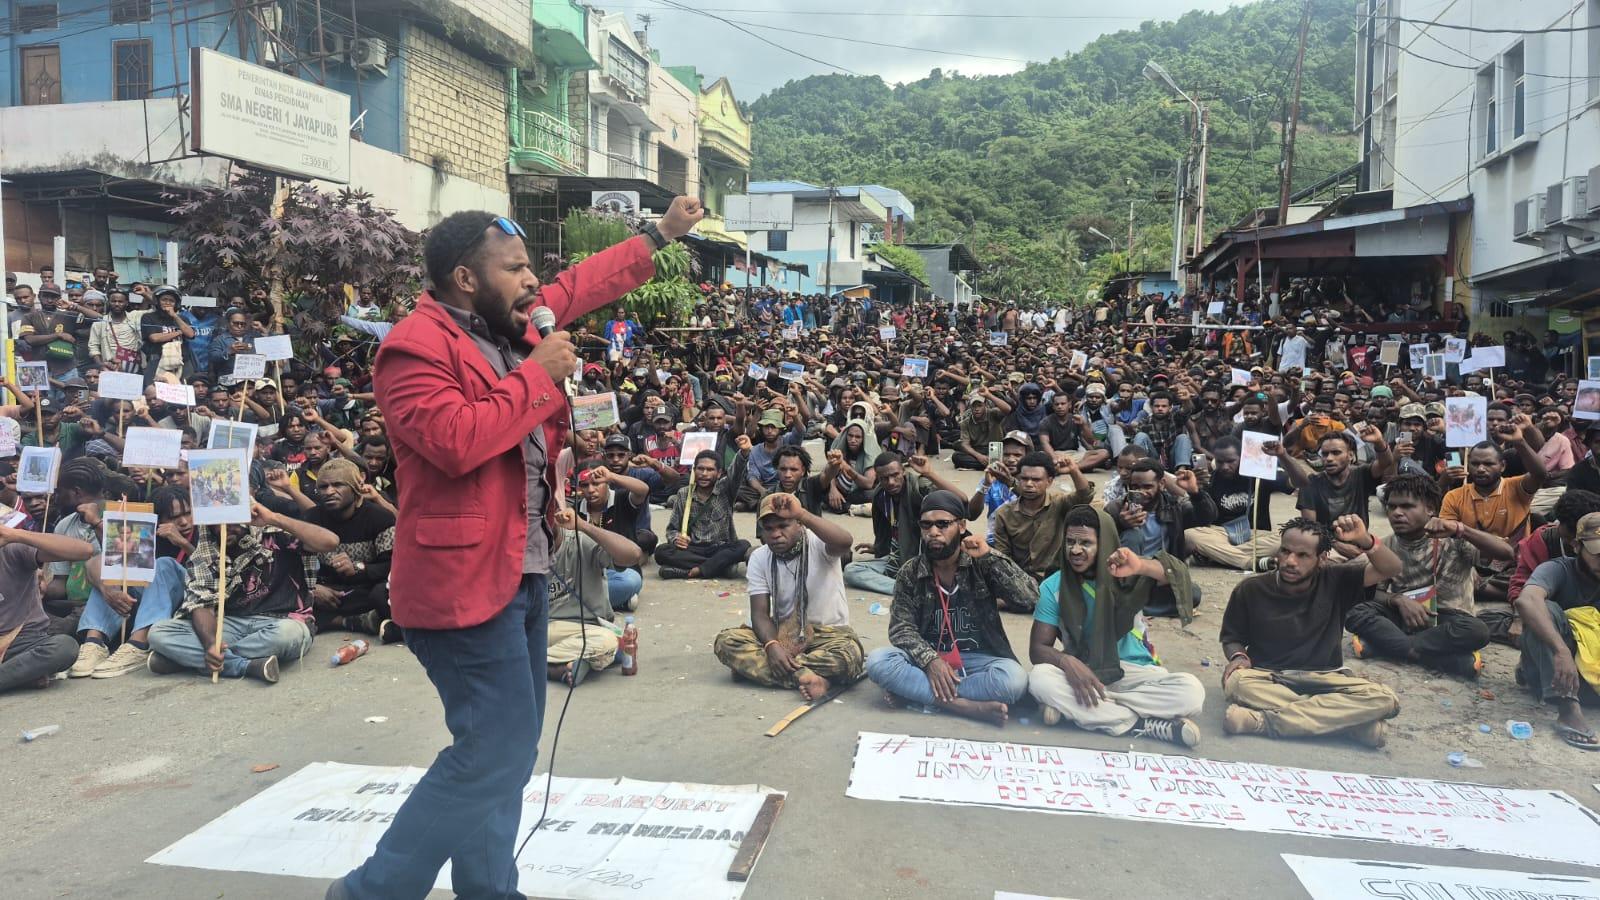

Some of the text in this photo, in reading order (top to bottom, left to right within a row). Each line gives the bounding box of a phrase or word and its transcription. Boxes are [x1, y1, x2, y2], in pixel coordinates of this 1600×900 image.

[220, 92, 242, 113] SMA
[246, 99, 282, 122] NEGERI
[285, 111, 290, 125] 1
[293, 114, 338, 139] JAYAPURA
[916, 760, 1131, 790] INVESTASI
[1149, 776, 1226, 798] DAN
[925, 740, 1064, 765] PAPUA
[1101, 752, 1310, 786] DARURAT
[997, 785, 1093, 808] NYA
